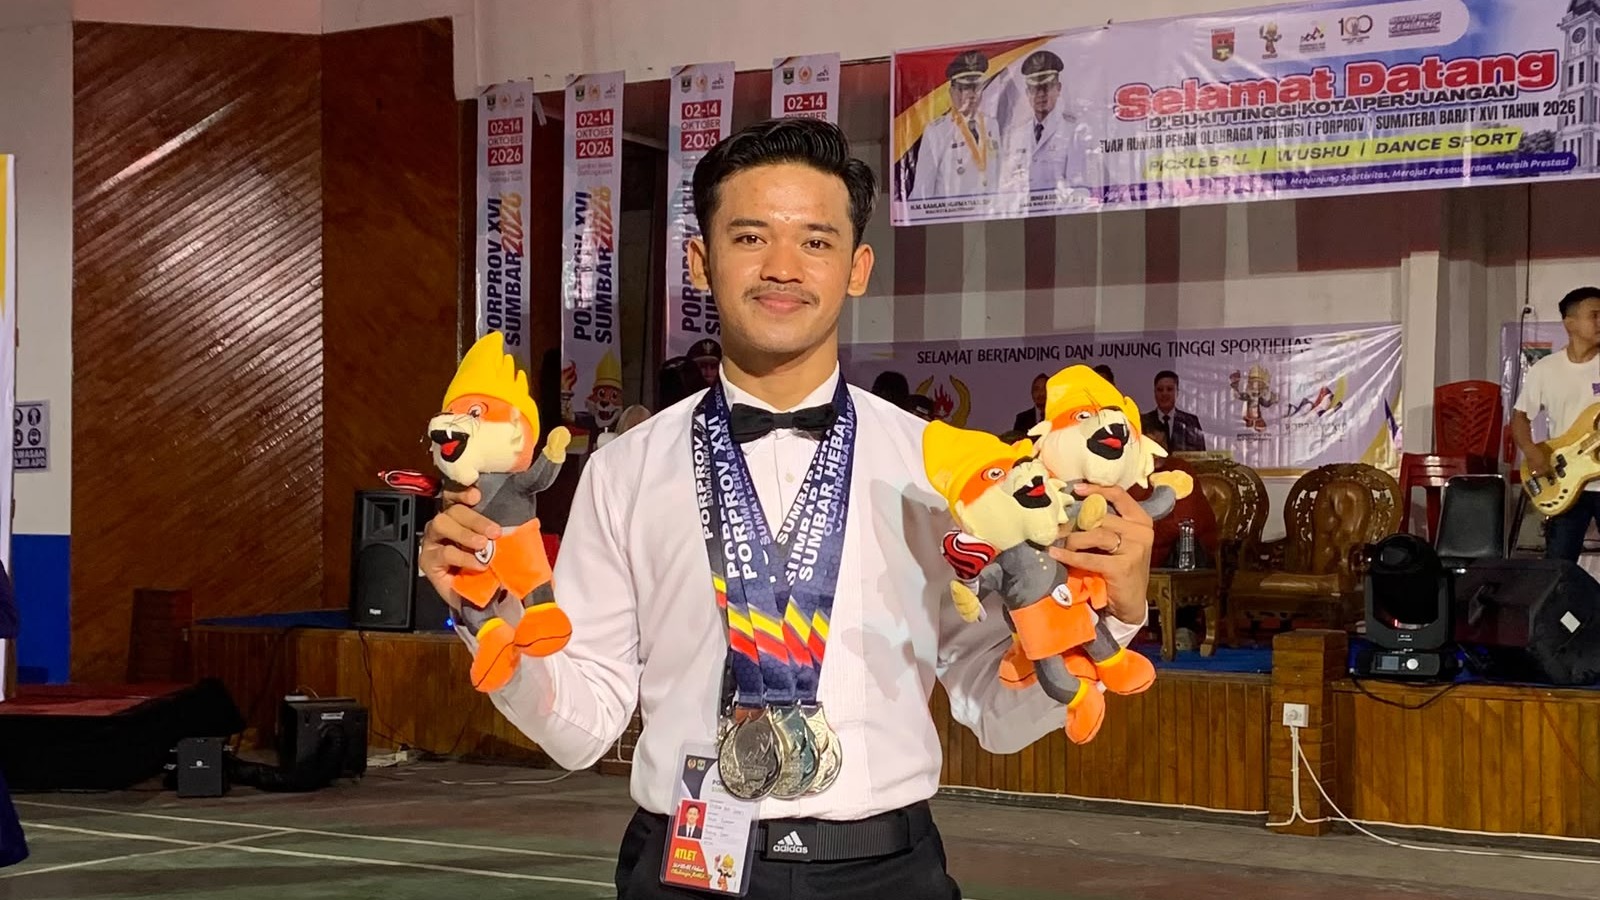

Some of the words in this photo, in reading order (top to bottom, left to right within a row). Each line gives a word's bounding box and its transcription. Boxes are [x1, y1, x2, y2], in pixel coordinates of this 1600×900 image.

[786, 94, 824, 110] 02-14
[1115, 67, 1334, 119] Selamat
[1346, 52, 1556, 97] Datang
[579, 111, 611, 126] 02-14
[684, 102, 718, 118] 02-14
[1172, 104, 1299, 127] BUKITTINGGI
[1301, 97, 1358, 117] KOTA
[1361, 84, 1516, 110] PERJUANGAN
[1315, 116, 1364, 136] PORPROV
[1375, 113, 1436, 130] SUMATERA
[1440, 108, 1475, 124] BARAT
[1479, 105, 1498, 121] XVI
[1502, 102, 1539, 119] TAHUN
[1543, 99, 1576, 116] 2026
[490, 119, 520, 135] 02-14
[576, 127, 614, 138] OKTOBER
[681, 119, 721, 130] OKTOBER
[684, 131, 717, 149] 2026
[490, 150, 521, 163] 2026
[579, 141, 611, 157] 2026
[1149, 153, 1250, 172] PICKLEBALL
[1277, 144, 1350, 163] WUSHU
[1374, 138, 1442, 155] DANCE
[1447, 131, 1518, 149] SPORT
[487, 197, 502, 234] XVI
[575, 191, 592, 226] XVI
[487, 238, 502, 334] ORPROV
[504, 251, 522, 346] SUMBAR
[595, 247, 613, 344] SUMBAR
[916, 348, 973, 365] SELAMAT
[977, 345, 1060, 364] BERTANDING
[1065, 344, 1094, 360] DAN
[1098, 341, 1161, 359] JUNJUNG
[1166, 340, 1216, 358] TINGGI
[707, 415, 726, 455] XVI
[719, 418, 736, 461] BARAT
[692, 436, 714, 540] PORPROV
[729, 462, 757, 541] SUMATERA
[824, 443, 850, 537] OLAHRAGA
[715, 460, 758, 580] PORPROV
[798, 482, 835, 582] SUMBAR
[673, 847, 698, 861] ATLET
[772, 844, 809, 854] adidas
